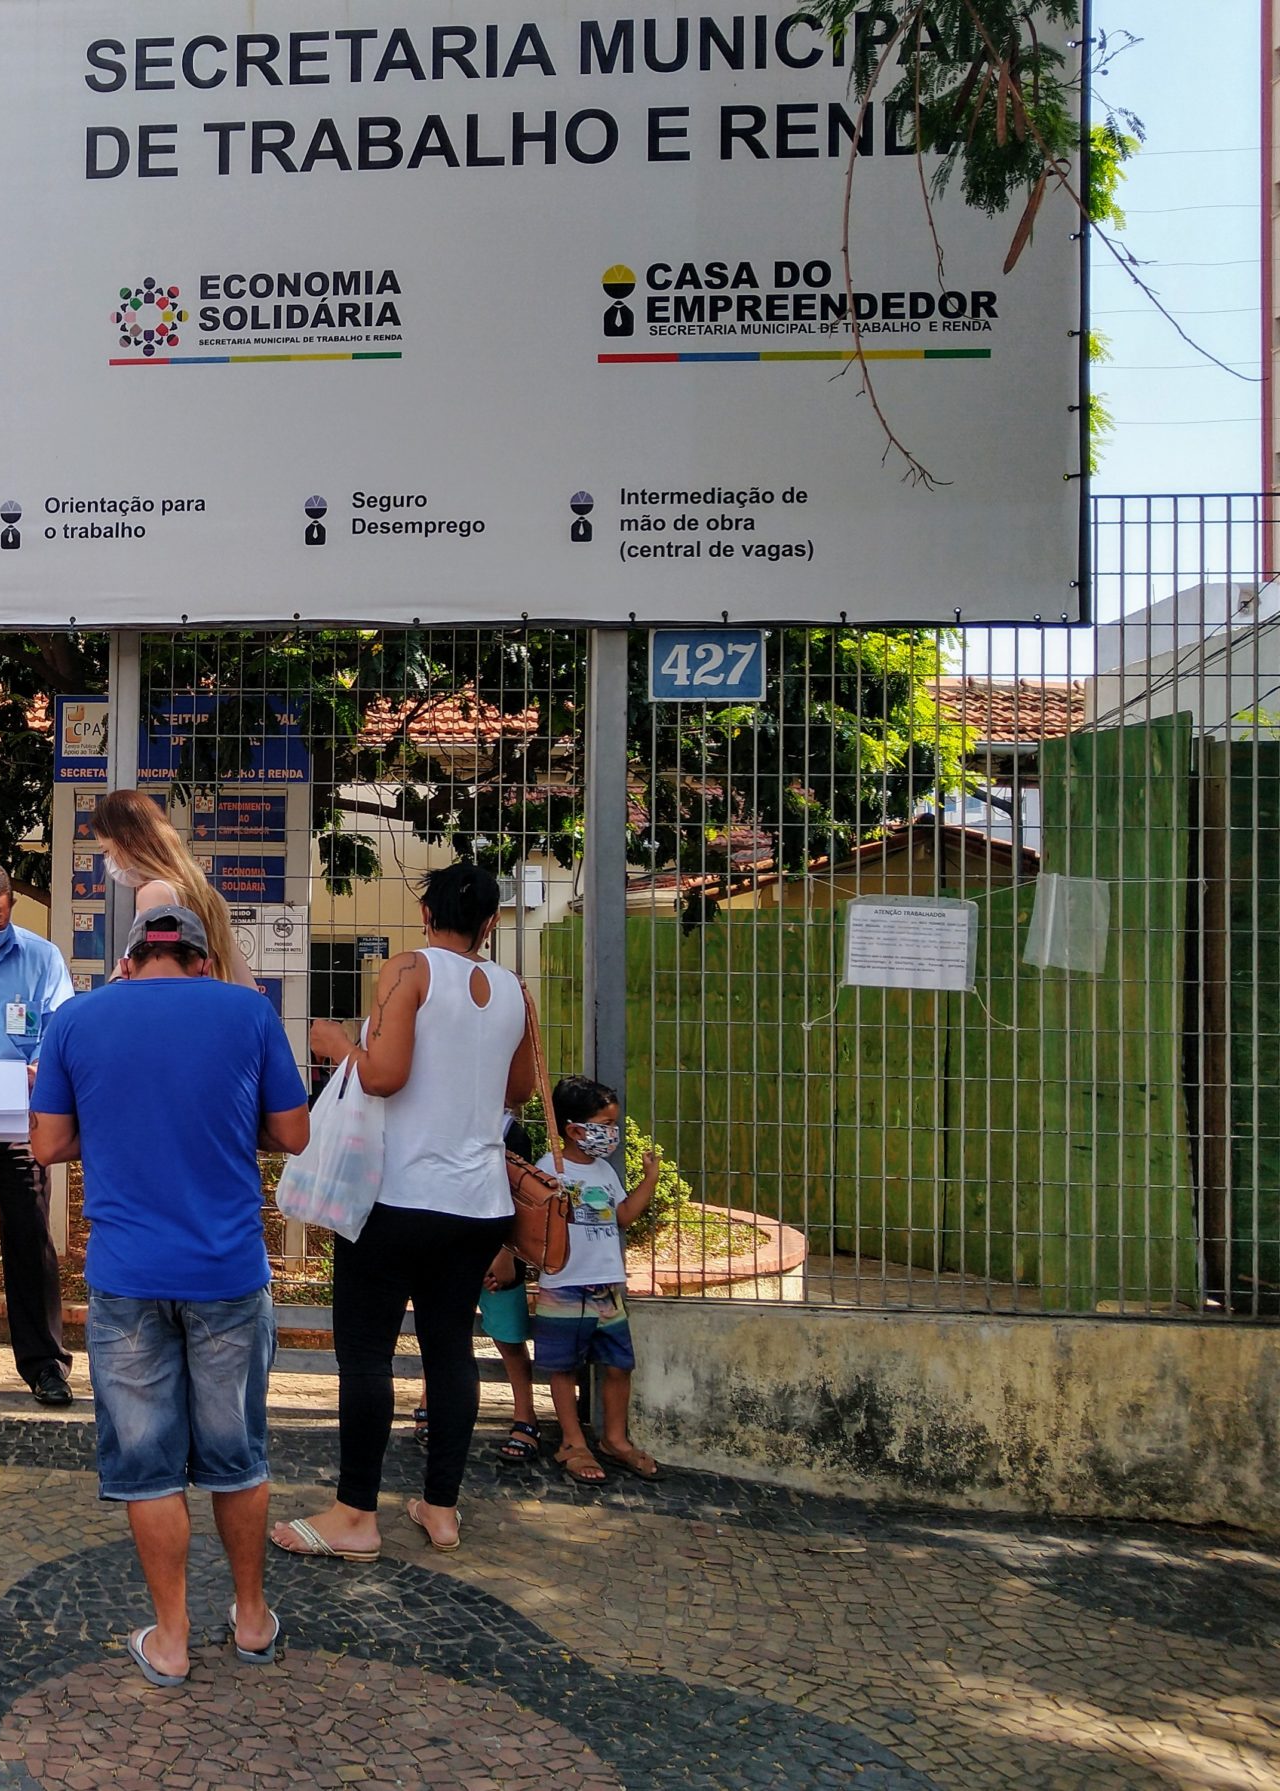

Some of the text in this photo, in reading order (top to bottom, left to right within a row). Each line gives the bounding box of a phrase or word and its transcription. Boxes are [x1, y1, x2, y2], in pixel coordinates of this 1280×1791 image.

[85, 23, 556, 92] SECRETARIA
[86, 124, 178, 179] DE
[204, 109, 618, 175] TRABALHO
[648, 107, 690, 161] E
[200, 270, 401, 299] ECONOMIA
[646, 260, 831, 290] CASA DO
[199, 298, 401, 331] SOLIDÁRIA
[647, 291, 998, 323] EMPREENDEDOR
[649, 318, 992, 337] SECRETARIA MUNICIPAL DE TRABALHO E RENDA
[198, 333, 403, 346] SECRETARIA MUNICIPAL DE TRABALHO E RENDA
[45, 496, 205, 516] Orientação para
[352, 492, 427, 512] Seguro
[621, 487, 807, 508] Intermediação de
[45, 522, 145, 539] o trabalho
[352, 518, 485, 537] Desemprego
[621, 514, 754, 531] mão de obra
[620, 540, 813, 562] (central de vagas)
[661, 642, 757, 686] 427
[74, 723, 108, 735] CPA
[60, 768, 108, 777] SECRETA
[268, 769, 304, 778] RENDA
[218, 803, 271, 811] ATENDIMENTO
[222, 867, 266, 876] ECONOMIA
[222, 880, 266, 891] SOLIDÁRIA
